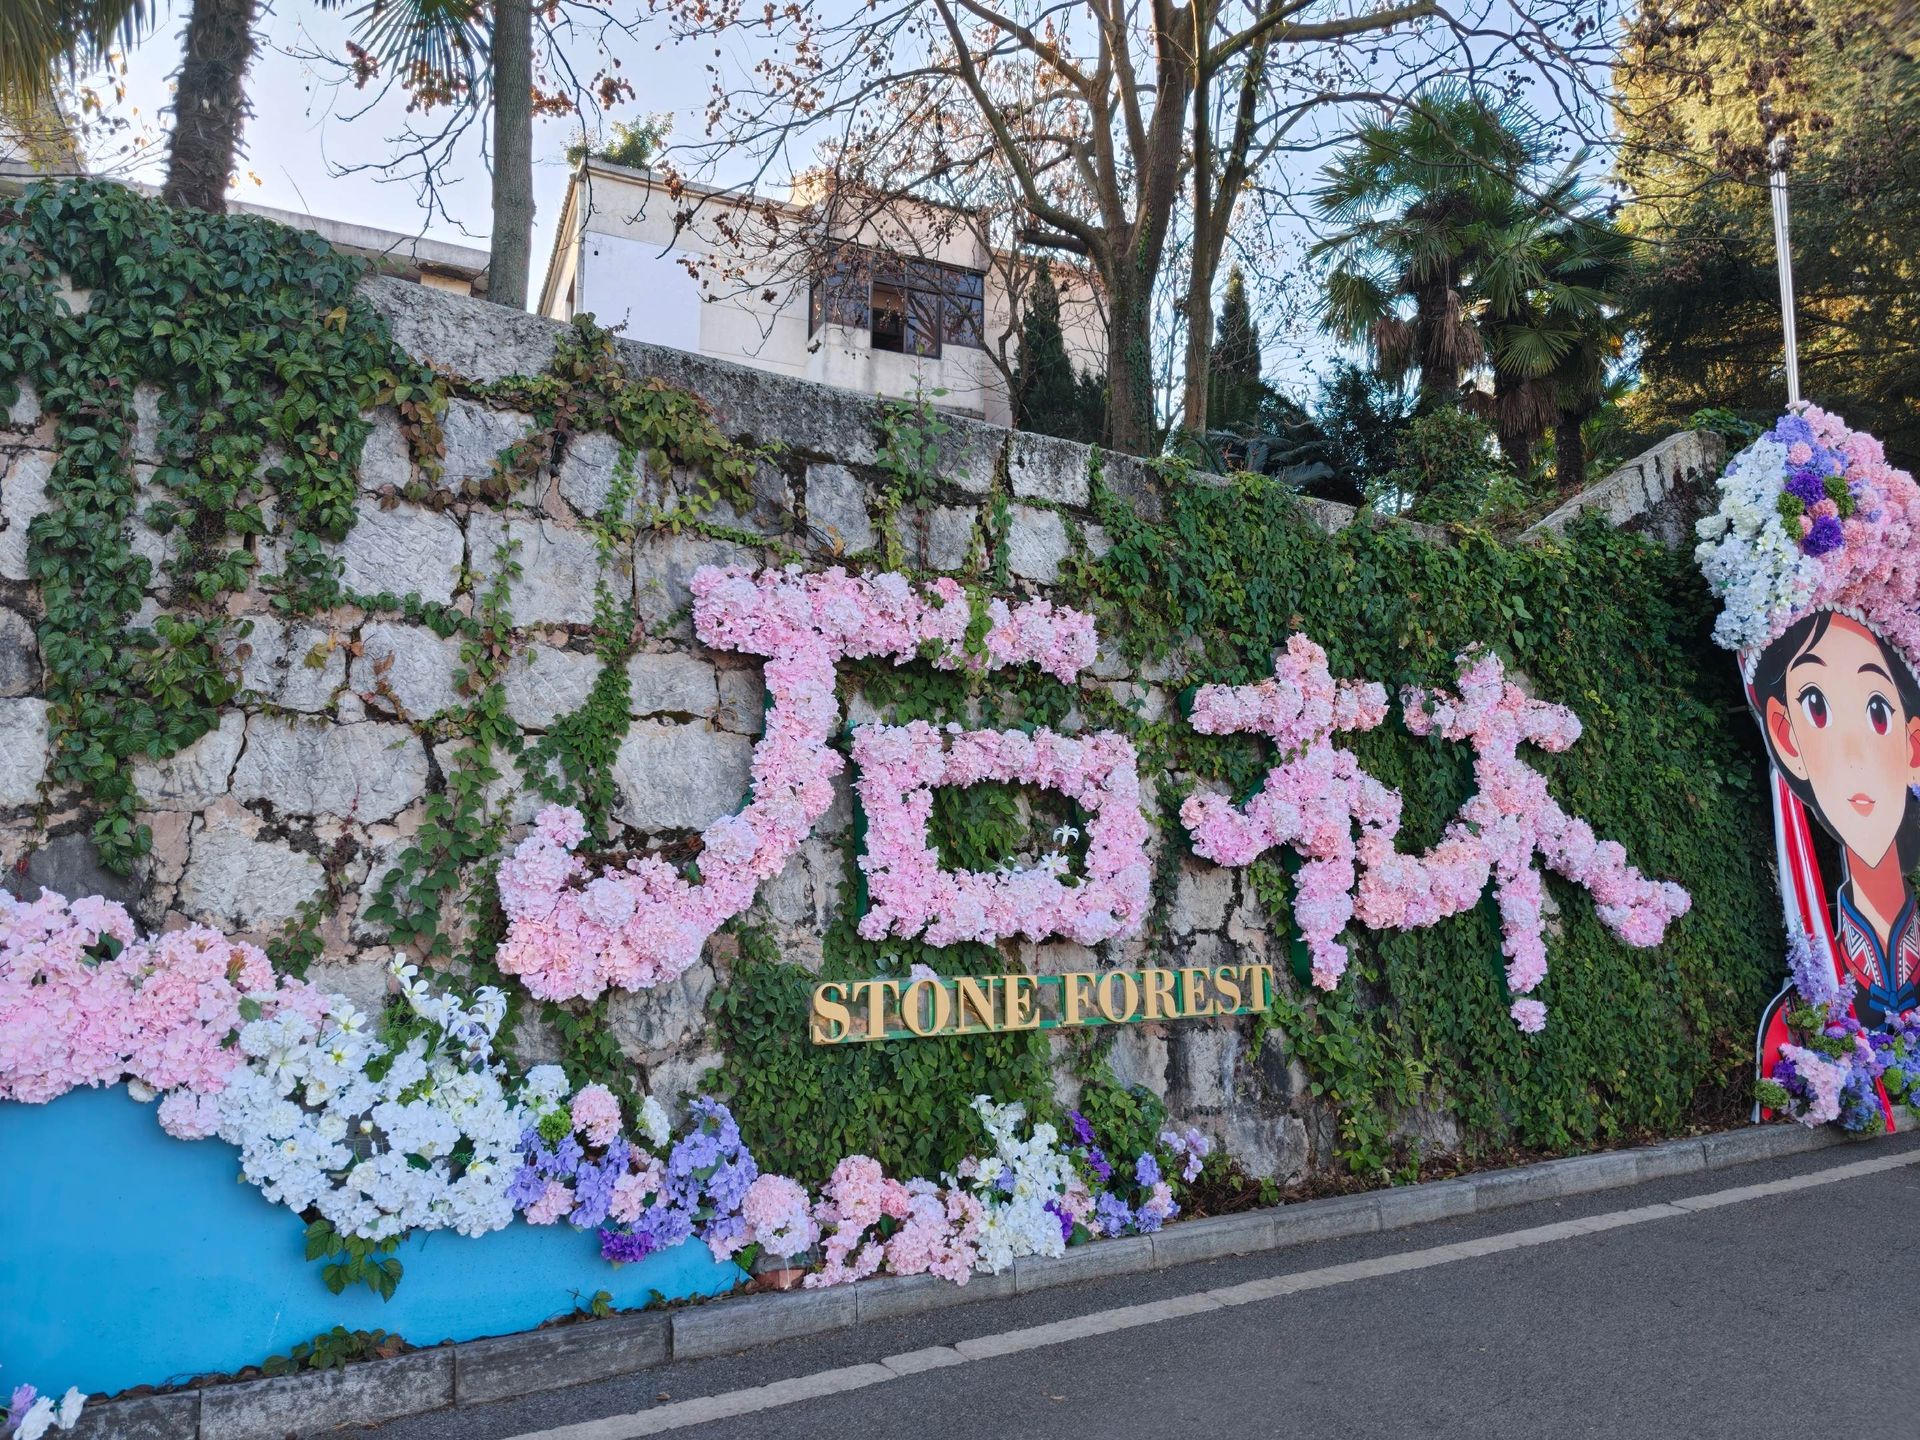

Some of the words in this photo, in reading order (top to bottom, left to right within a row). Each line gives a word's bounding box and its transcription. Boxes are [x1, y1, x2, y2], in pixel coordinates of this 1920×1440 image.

[496, 563, 1692, 1032] 石林
[811, 974, 1041, 1045] STONE
[1062, 965, 1274, 1026] FOREST
